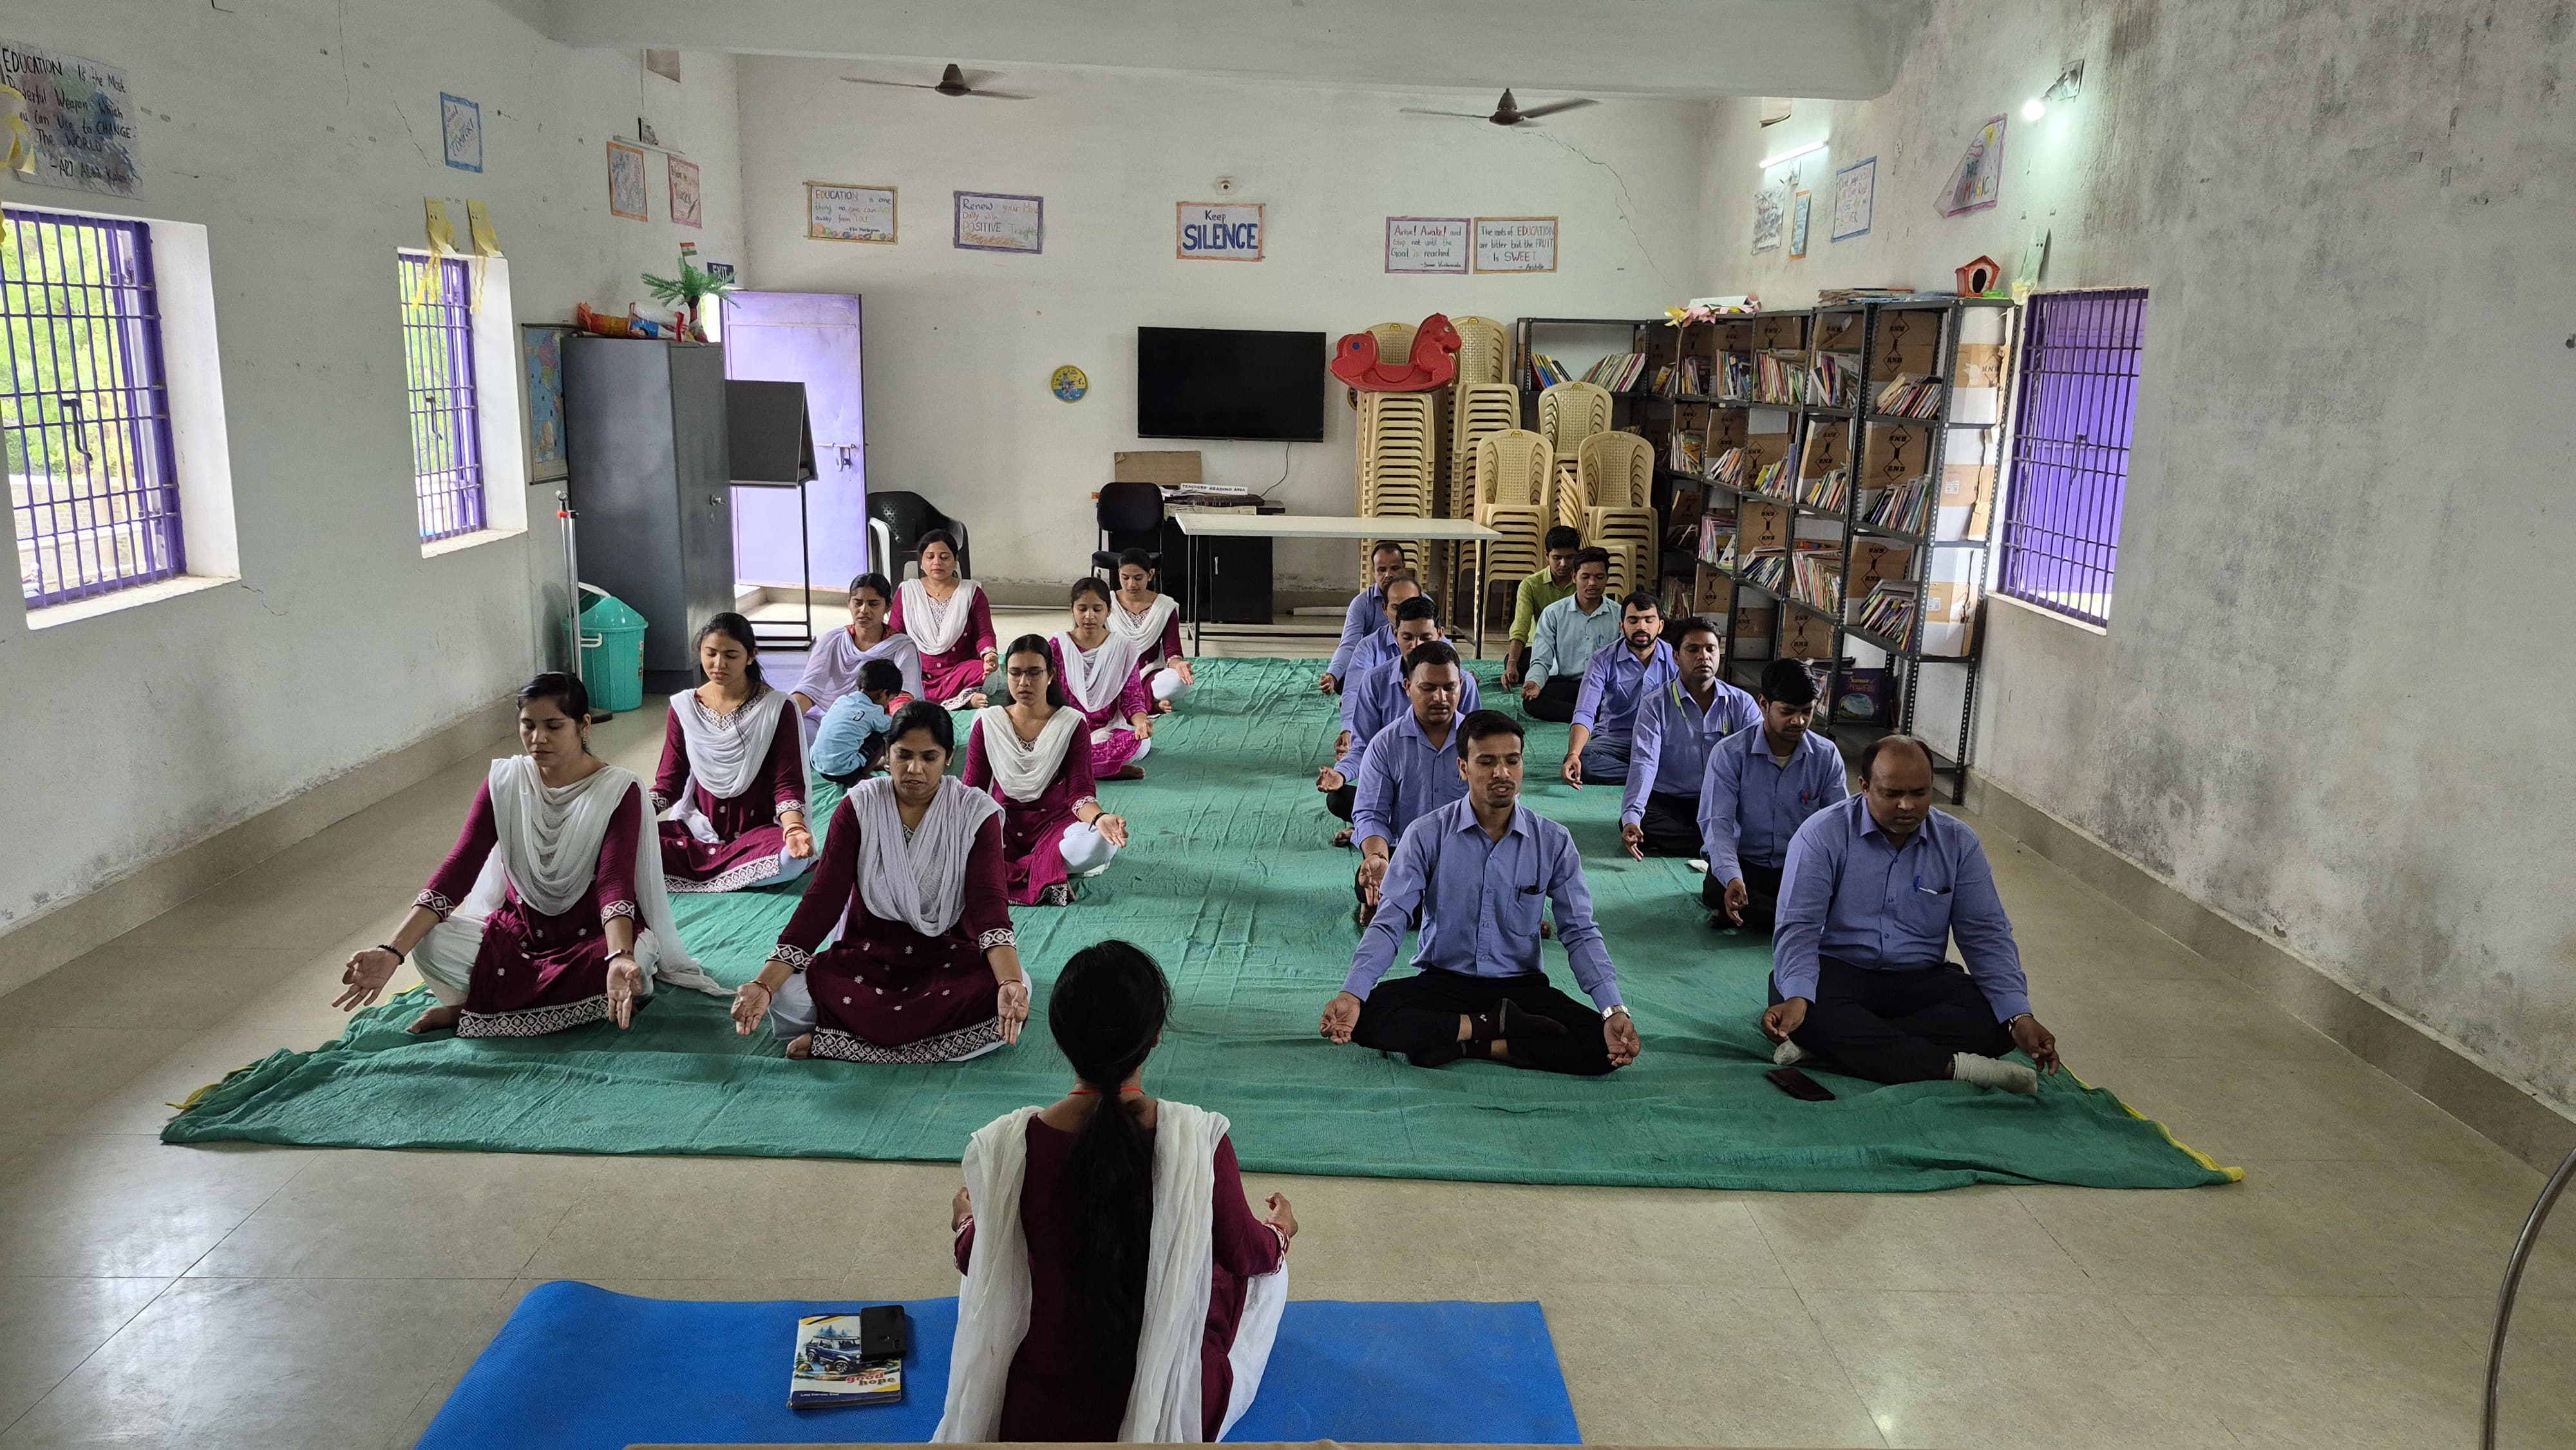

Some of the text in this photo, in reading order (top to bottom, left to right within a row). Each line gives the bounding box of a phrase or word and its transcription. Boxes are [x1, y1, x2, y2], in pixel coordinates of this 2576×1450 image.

[3, 48, 126, 93] EDUCATION Is the Most
[54, 87, 88, 113] Weapon
[98, 100, 124, 119] Which
[34, 109, 49, 126] Can
[57, 115, 73, 129] Use
[82, 118, 92, 135] to
[35, 127, 102, 152] The WORLD
[1966, 160, 1979, 178] ARE
[815, 189, 858, 201] EDUCATION
[1963, 176, 1990, 202] MAGIC
[814, 202, 831, 215] thing
[963, 198, 994, 211] Renew
[1003, 205, 1020, 214] your
[838, 214, 851, 223] from
[1205, 209, 1226, 223] Keep
[963, 221, 1002, 232] POSITIVE
[1394, 225, 1461, 237] Arise! Awake! and
[1481, 225, 1555, 236] The roots of EDUCATION
[1182, 223, 1258, 250] SILENCE
[1491, 239, 1508, 249] bitter
[1511, 239, 1520, 249] but
[1524, 239, 1533, 249] the
[1535, 238, 1553, 248] FRUIT
[1390, 247, 1408, 258] Goal
[1424, 248, 1449, 258] reached
[1493, 251, 1536, 262] Is SWEET
[712, 265, 727, 284] EXIT
[846, 1372, 885, 1384] good
[858, 1377, 896, 1386] hope
